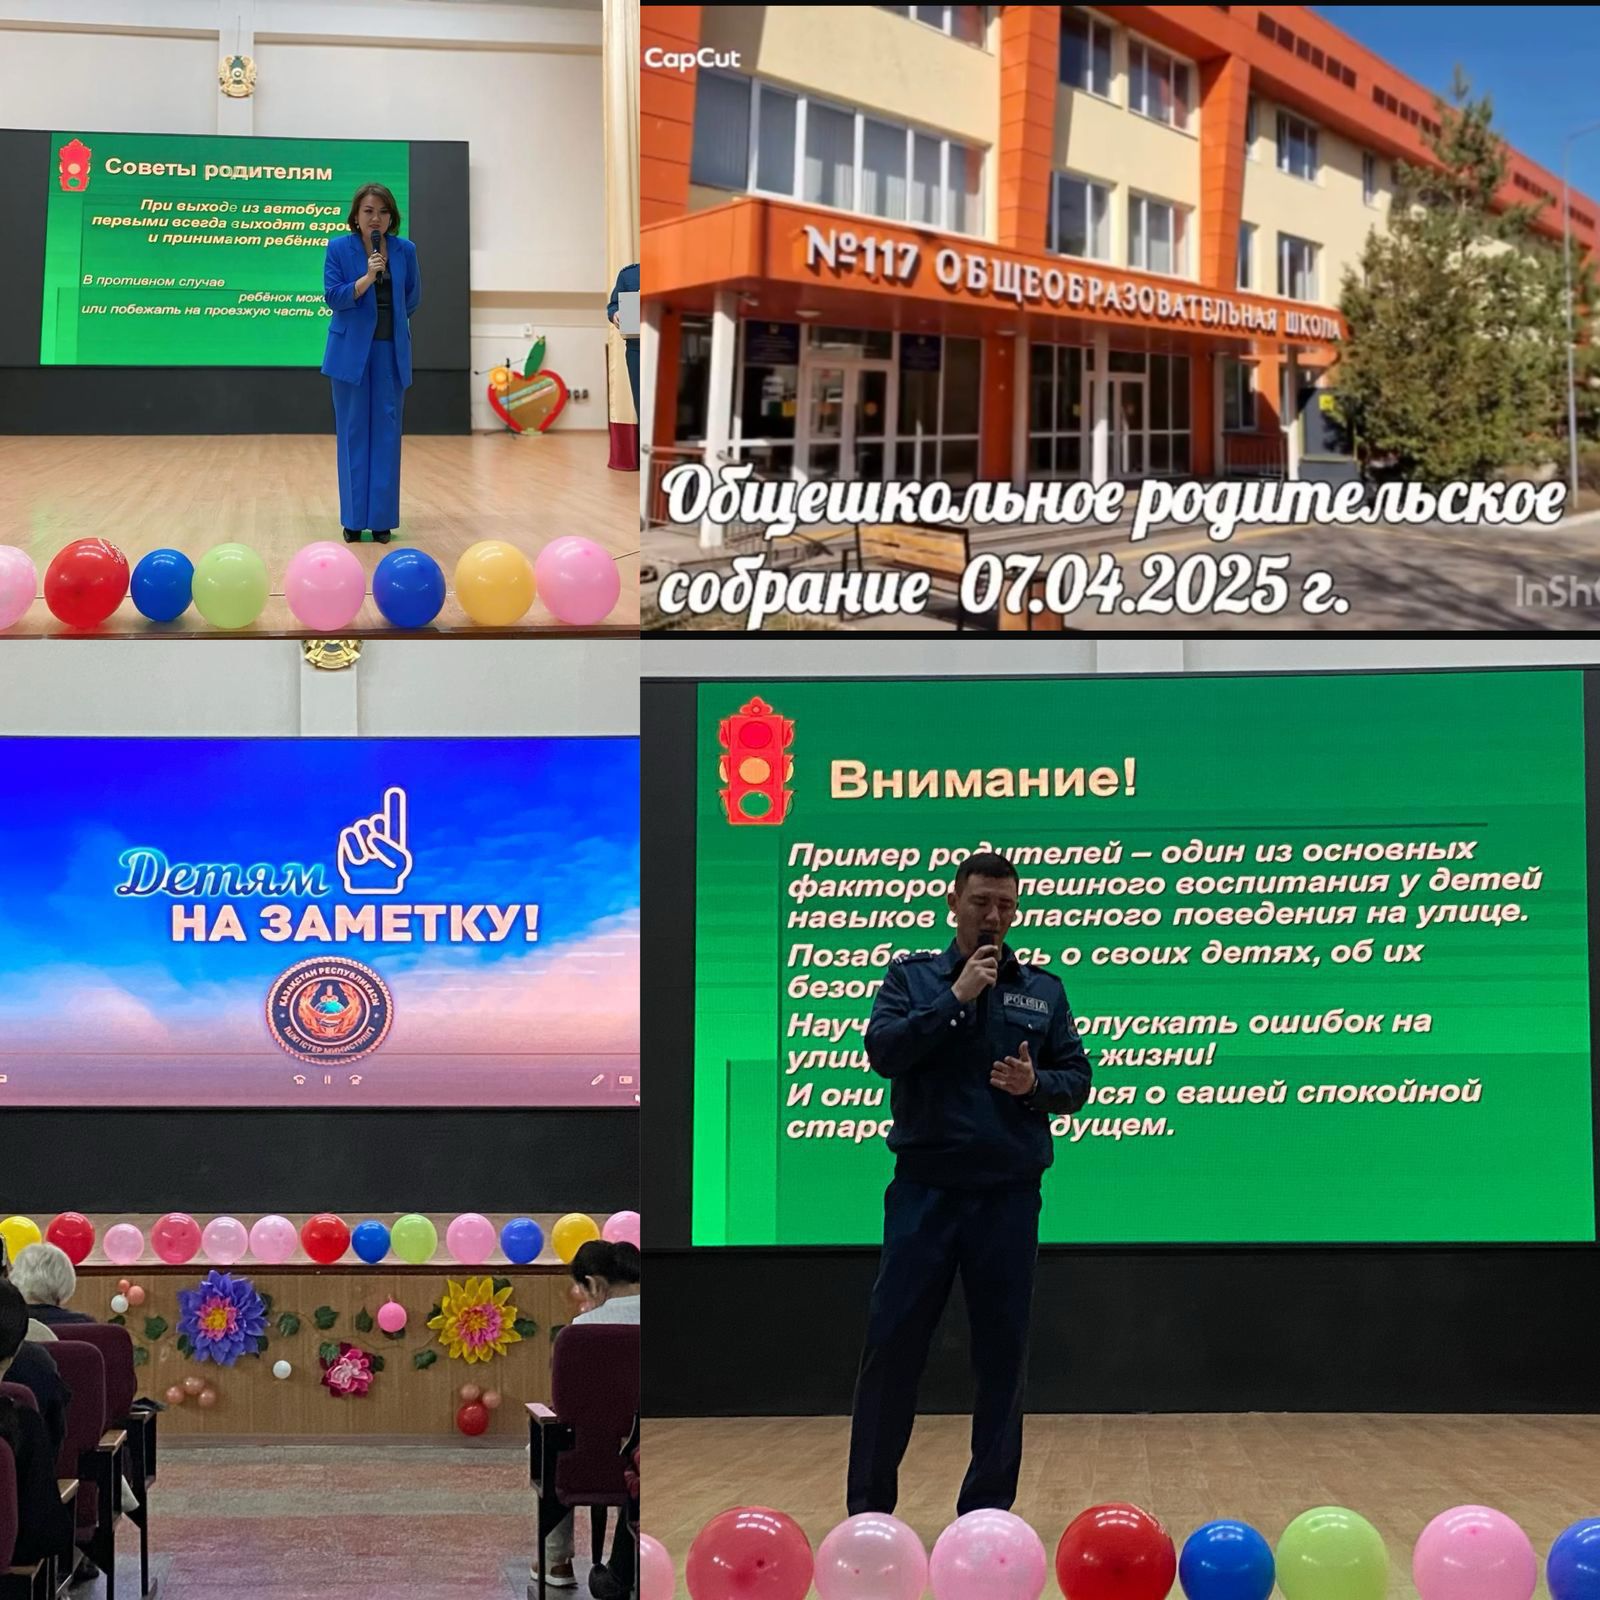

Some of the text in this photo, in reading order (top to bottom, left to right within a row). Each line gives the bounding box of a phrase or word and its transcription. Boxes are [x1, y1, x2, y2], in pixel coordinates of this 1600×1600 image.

[105, 158, 333, 180] Советы родителям
[92, 215, 168, 229] первыми
[172, 217, 227, 229] всегда
[231, 218, 305, 230] выходят
[141, 199, 341, 217] При выходе из автобуса
[148, 233, 329, 249] и принимают ребёнка
[83, 275, 225, 290] В противном случае
[804, 226, 1341, 339] №117 ОБЩЕОБРАЗОВАТЕЛЬНАЯ ШКОЛА
[82, 304, 334, 320] или побежать на проезжую часть до
[238, 292, 294, 304] ребёнок
[829, 757, 1138, 801] Внимание!
[788, 842, 920, 871] Пример
[1161, 839, 1245, 864] один
[1255, 844, 1292, 862] из
[1302, 841, 1477, 862] основных
[116, 846, 331, 898] Детям
[1018, 876, 1165, 896] пешного
[1174, 872, 1389, 896] воспитания
[1398, 872, 1421, 897] у
[1429, 866, 1543, 892] детей
[171, 904, 539, 943] НА ЗАМЕТКУ!
[788, 909, 935, 928] навыков
[1172, 901, 1357, 927] поведения
[1366, 904, 1406, 924] на
[1416, 903, 1528, 928] улице.
[1061, 947, 1082, 965] о
[1092, 944, 1192, 965] своих
[1201, 940, 1321, 968] детях,
[1331, 938, 1374, 963] об
[1383, 942, 1424, 962] их
[319, 967, 379, 1006] РЕСПУБЛИКАСЫ
[787, 1009, 1432, 1042] Науч опускать ошибок на
[785, 1042, 1217, 1074] улиц жизни!
[786, 1083, 813, 1106] И
[821, 1088, 884, 1106] они
[1145, 1086, 1166, 1104] о
[1176, 1080, 1288, 1104] вашей
[1297, 1078, 1482, 1102] спокойной
[786, 1114, 1174, 1143] старо дущем.
